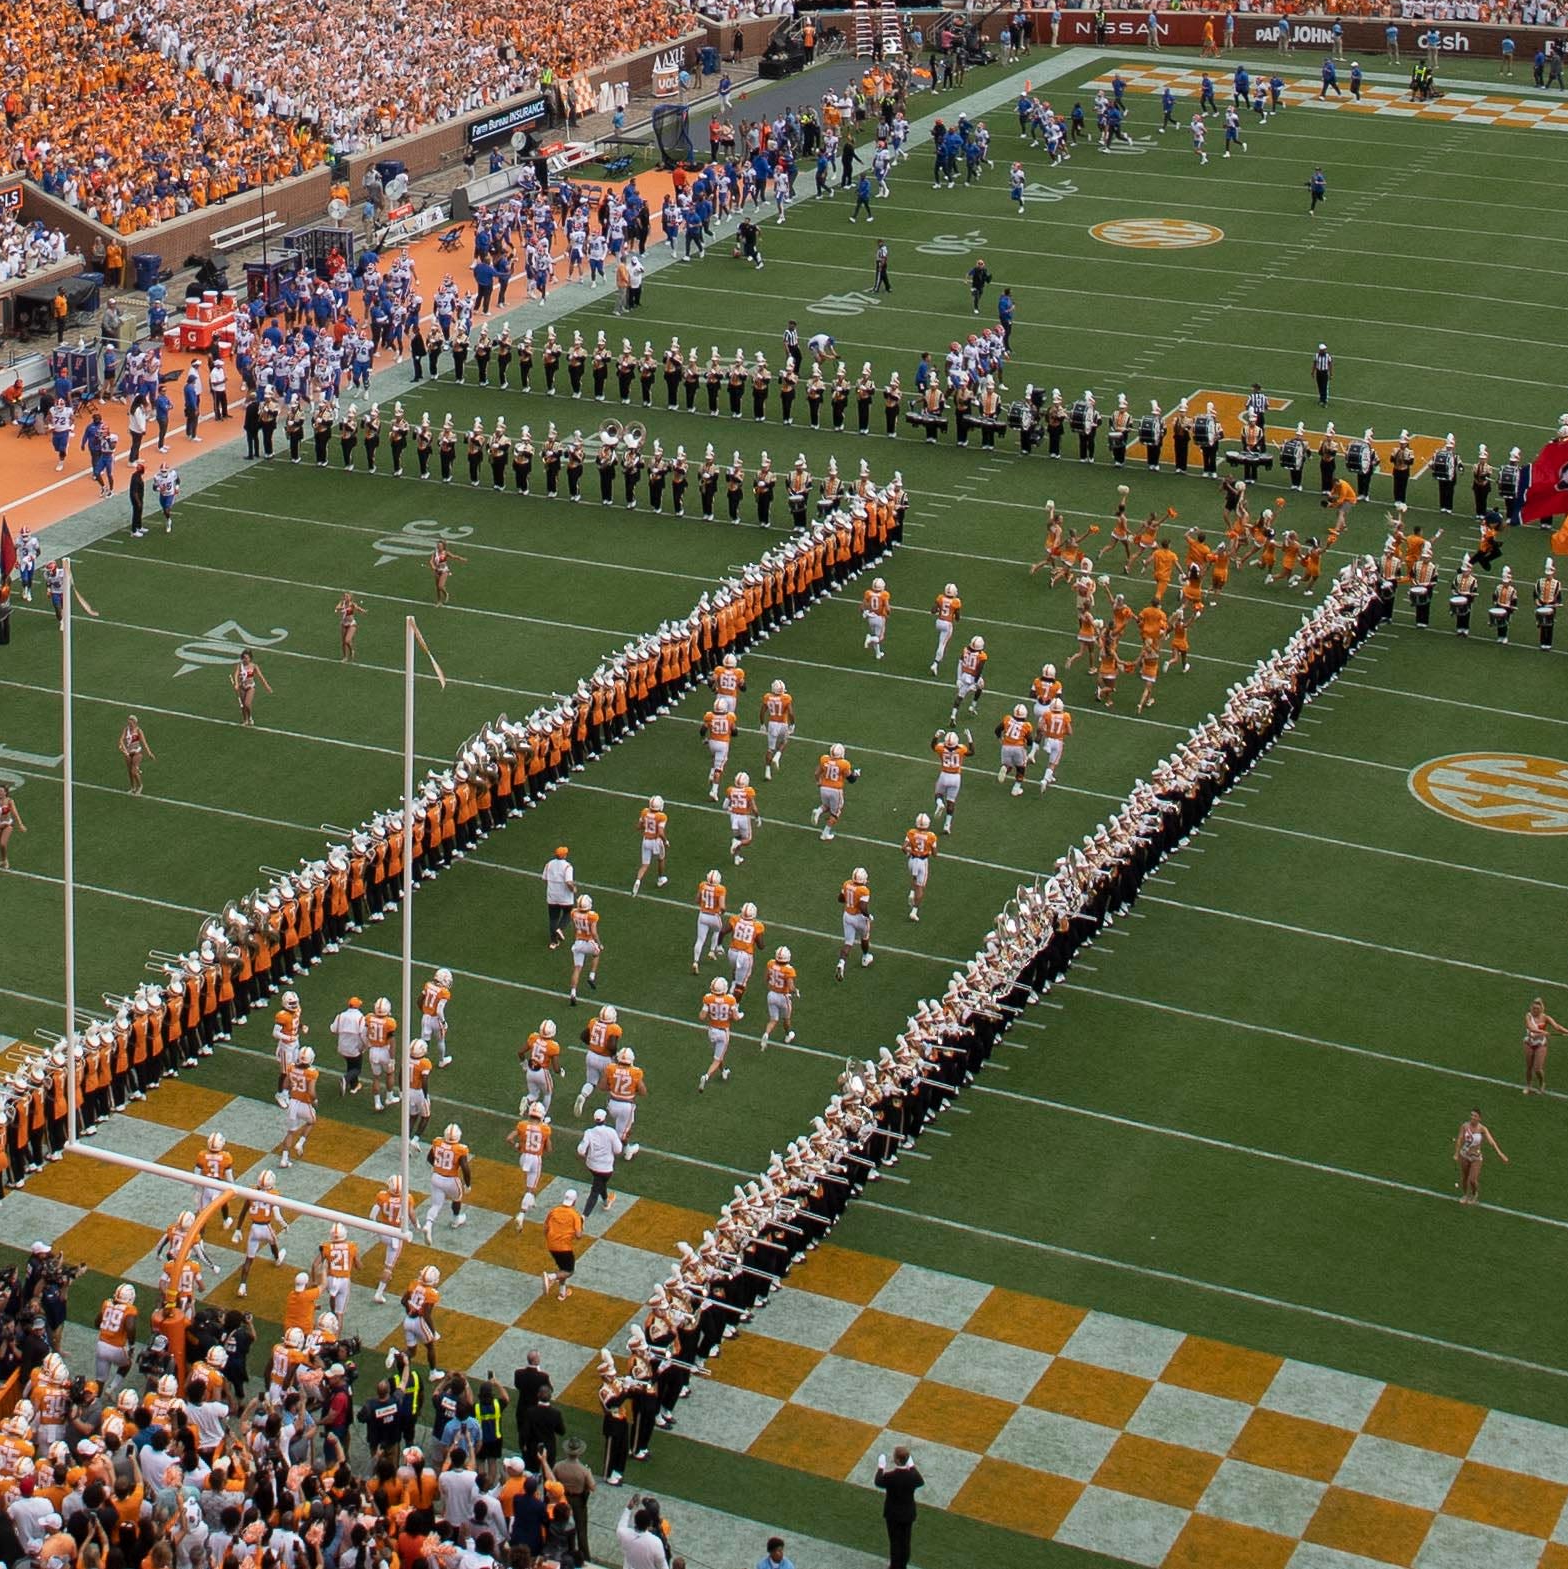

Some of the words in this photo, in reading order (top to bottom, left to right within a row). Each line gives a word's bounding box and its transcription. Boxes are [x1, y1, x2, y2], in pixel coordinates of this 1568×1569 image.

[1076, 22, 1169, 36] NSSAN
[1256, 27, 1291, 42] PAP
[1417, 32, 1469, 51] dsh
[472, 120, 488, 136] Farm
[489, 114, 509, 130] Bureau
[509, 100, 545, 122] INSURANCE
[330, 1249, 349, 1271] 21
